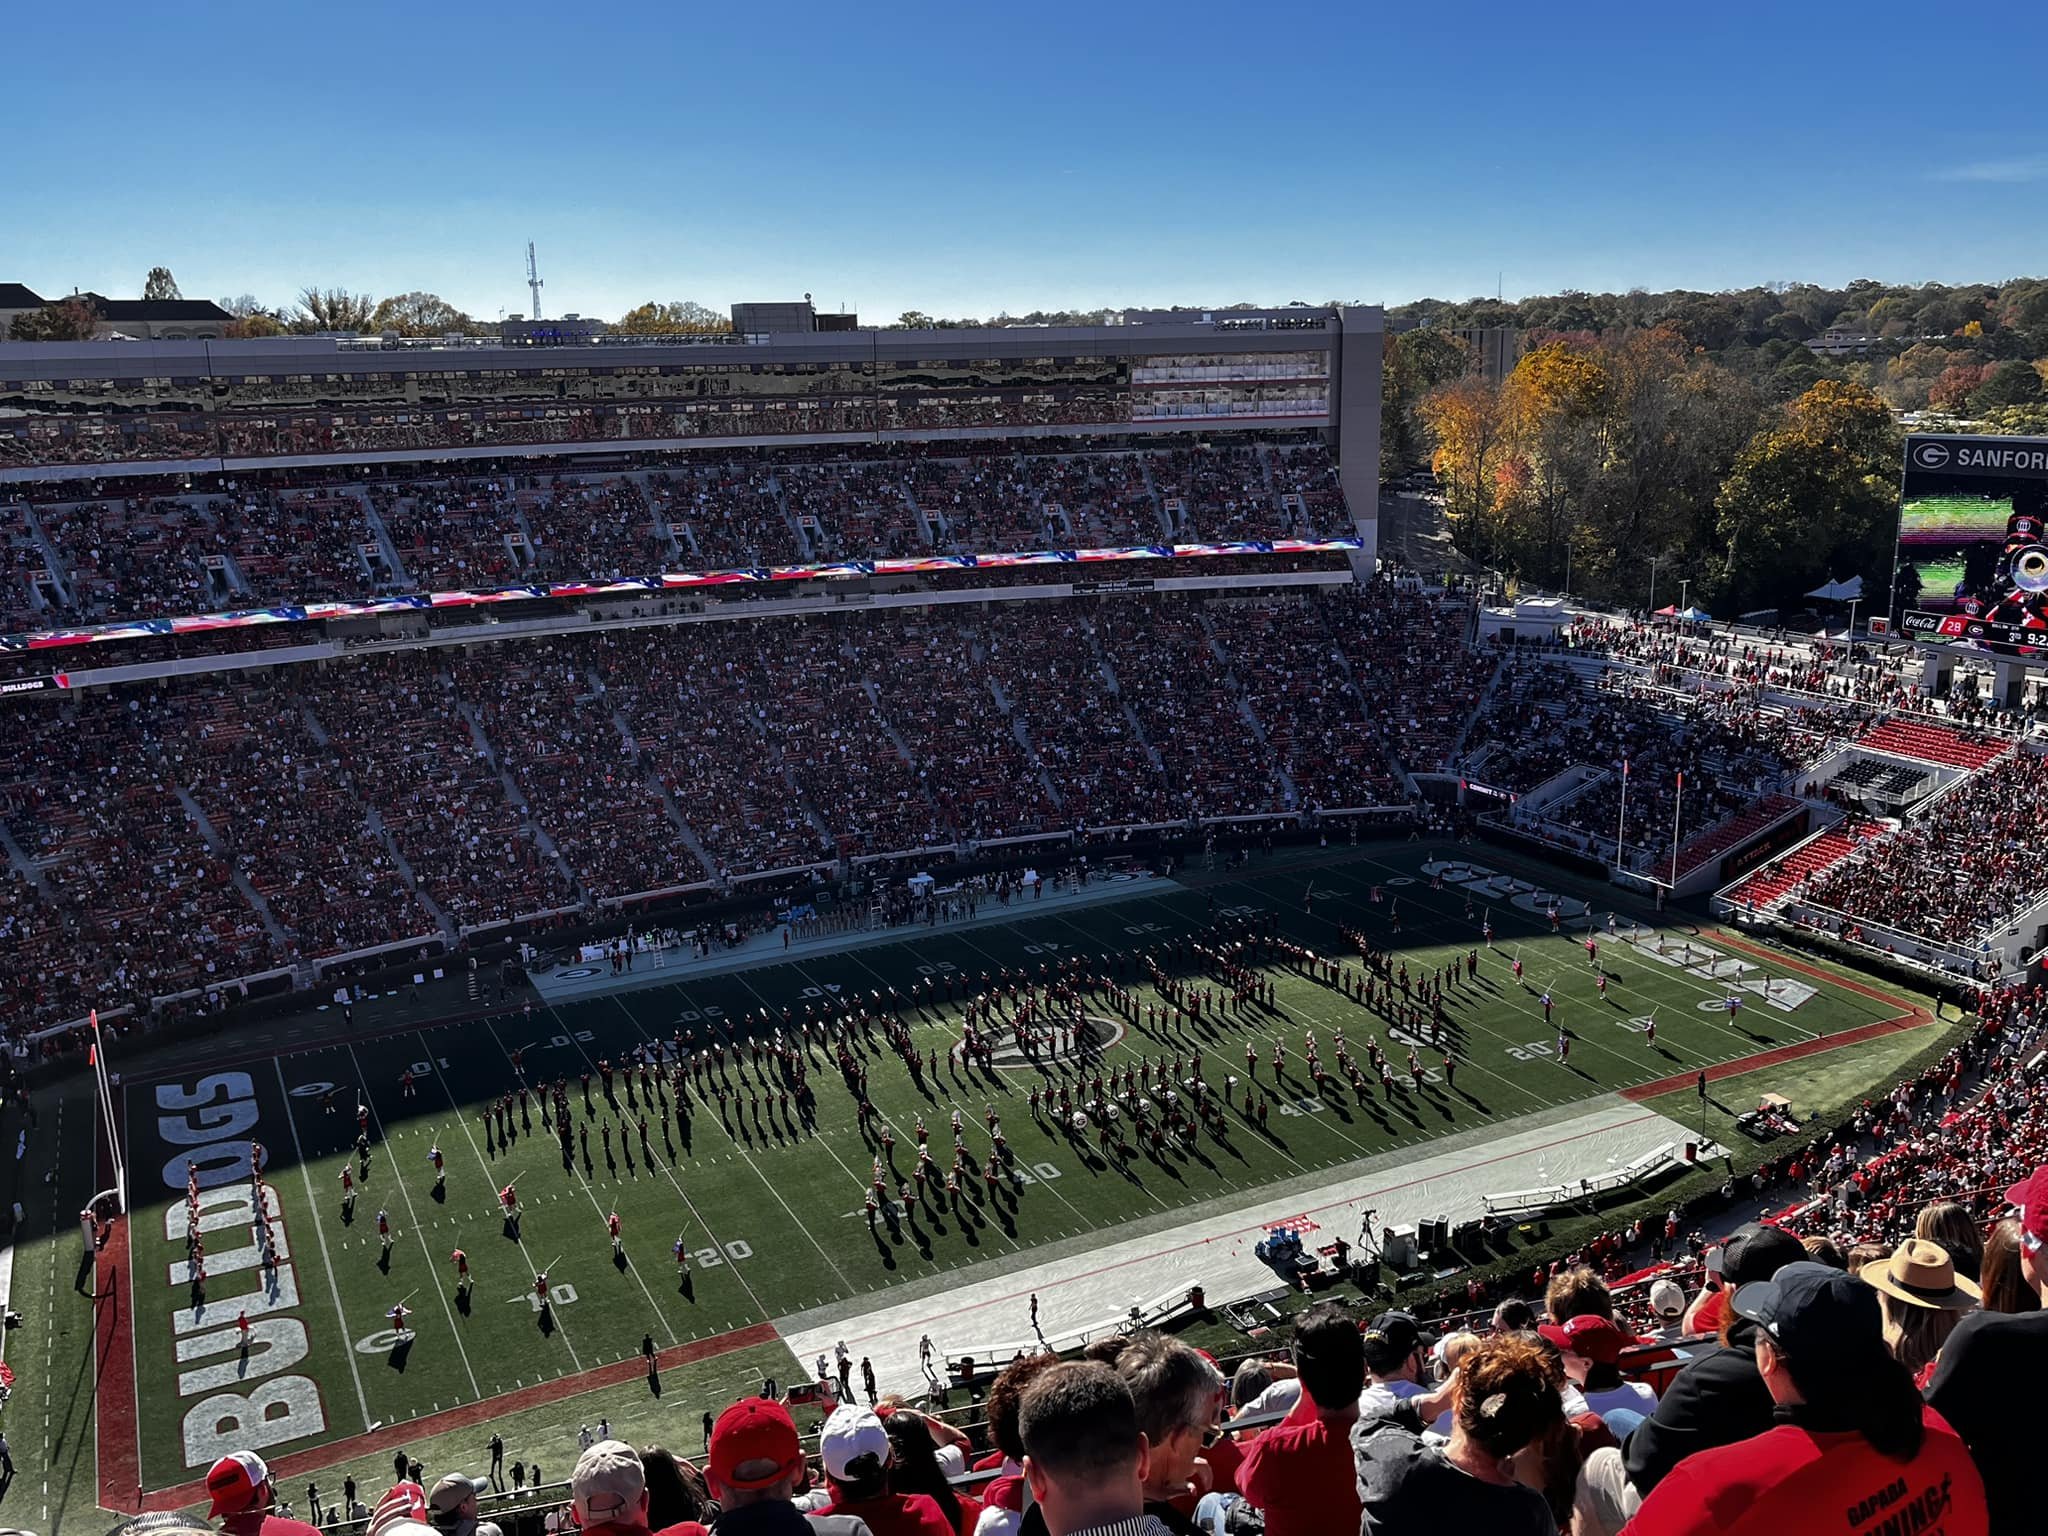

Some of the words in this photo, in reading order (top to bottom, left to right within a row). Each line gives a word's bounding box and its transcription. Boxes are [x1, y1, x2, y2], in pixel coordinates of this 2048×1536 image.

[1947, 621, 1961, 632] 28
[2027, 633, 2048, 646] 9:2
[2, 681, 44, 692] BULLDOGS
[680, 1006, 723, 1021] 30
[551, 1030, 596, 1047] 20
[1504, 1042, 1555, 1061] 20
[411, 1057, 450, 1074] 10
[1012, 1163, 1062, 1186] 40
[694, 1240, 753, 1269] 20
[155, 1071, 327, 1468] BULLDOGS
[527, 1284, 579, 1312] 10
[355, 1328, 416, 1354] G
